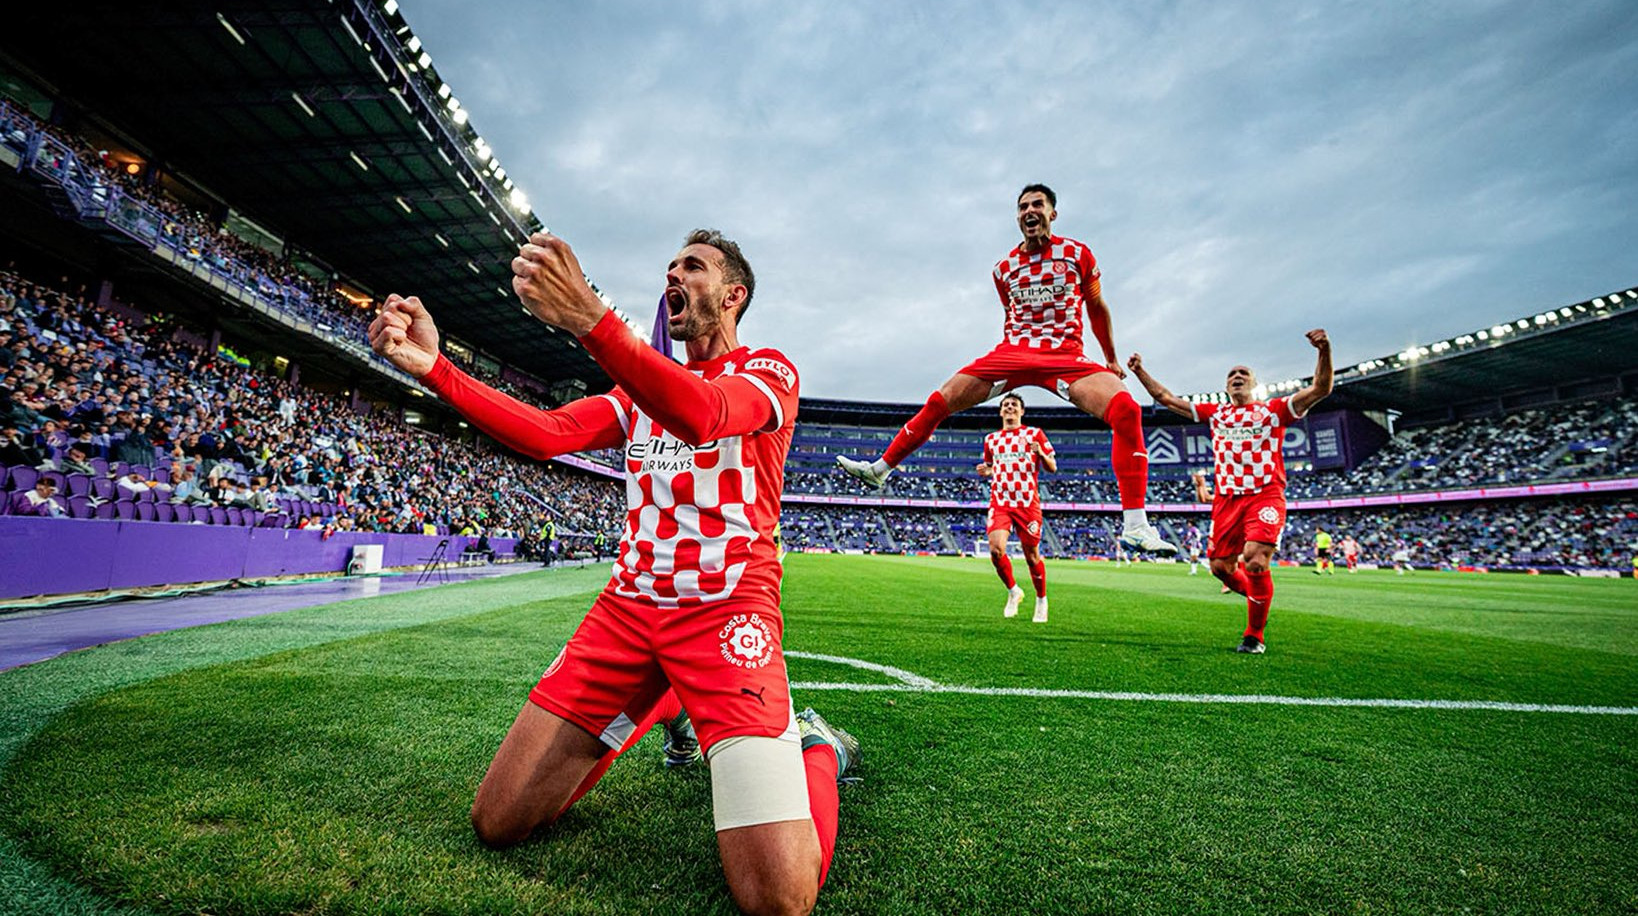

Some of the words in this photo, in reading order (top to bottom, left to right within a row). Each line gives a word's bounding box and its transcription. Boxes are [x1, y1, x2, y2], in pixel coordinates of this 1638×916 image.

[718, 614, 748, 639] Costa
[750, 613, 772, 642] Brava
[719, 642, 744, 667] Pirineu
[745, 661, 757, 669] de
[740, 634, 759, 651] G!
